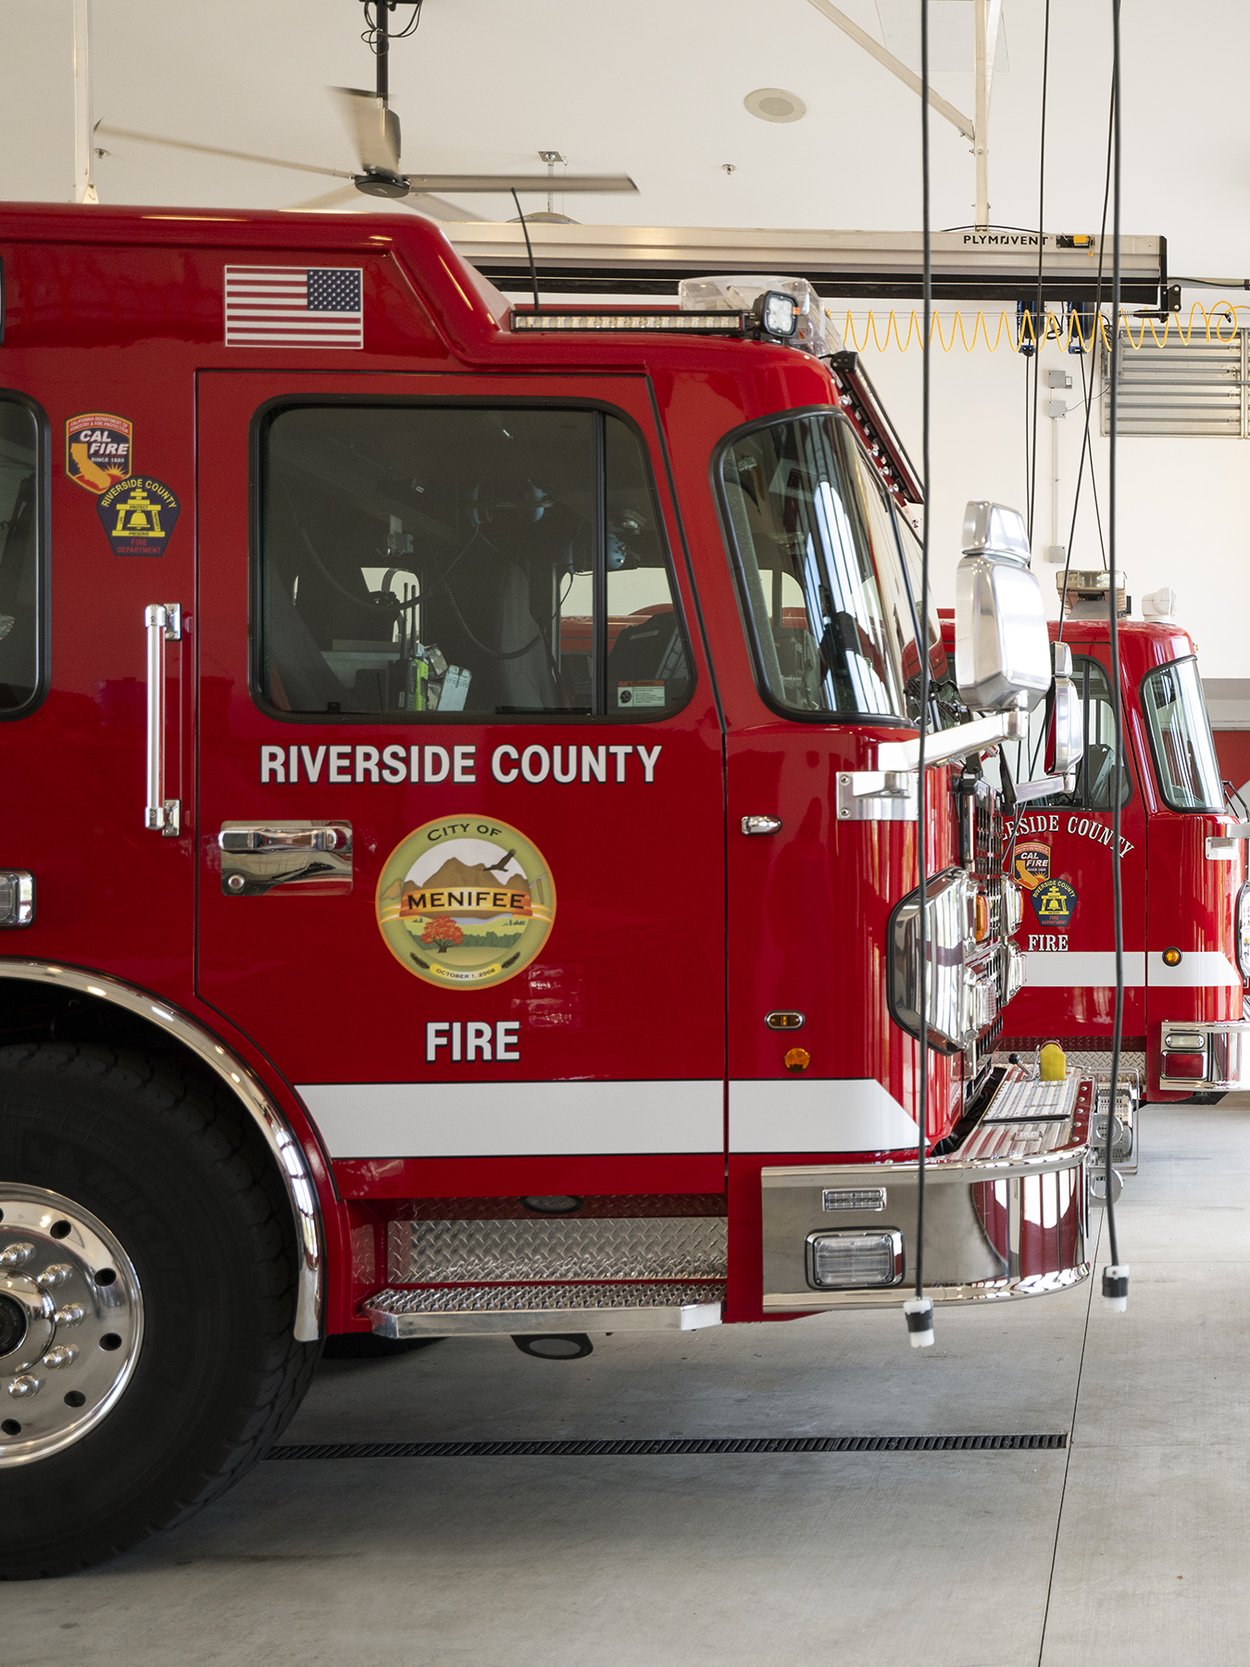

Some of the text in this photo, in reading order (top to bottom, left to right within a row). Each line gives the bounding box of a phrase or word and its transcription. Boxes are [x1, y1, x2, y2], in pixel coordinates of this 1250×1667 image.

[964, 235, 1048, 245] PLYMOVENT
[80, 430, 112, 442] CAL
[89, 443, 129, 455] FIRE
[101, 479, 177, 508] RIVERSIDE COUNTY
[131, 538, 148, 546] FIRE
[260, 744, 662, 785] RIVERSIDE COUNTY
[427, 823, 502, 842] CITY OF
[1020, 852, 1039, 860] CAL
[1026, 859, 1049, 867] FIRE
[1057, 880, 1076, 898] COUNTY
[407, 891, 525, 910] MENIFEE
[1028, 934, 1069, 951] FIRE
[435, 968, 470, 979] OCTOBER
[425, 1021, 521, 1063] FIRE
